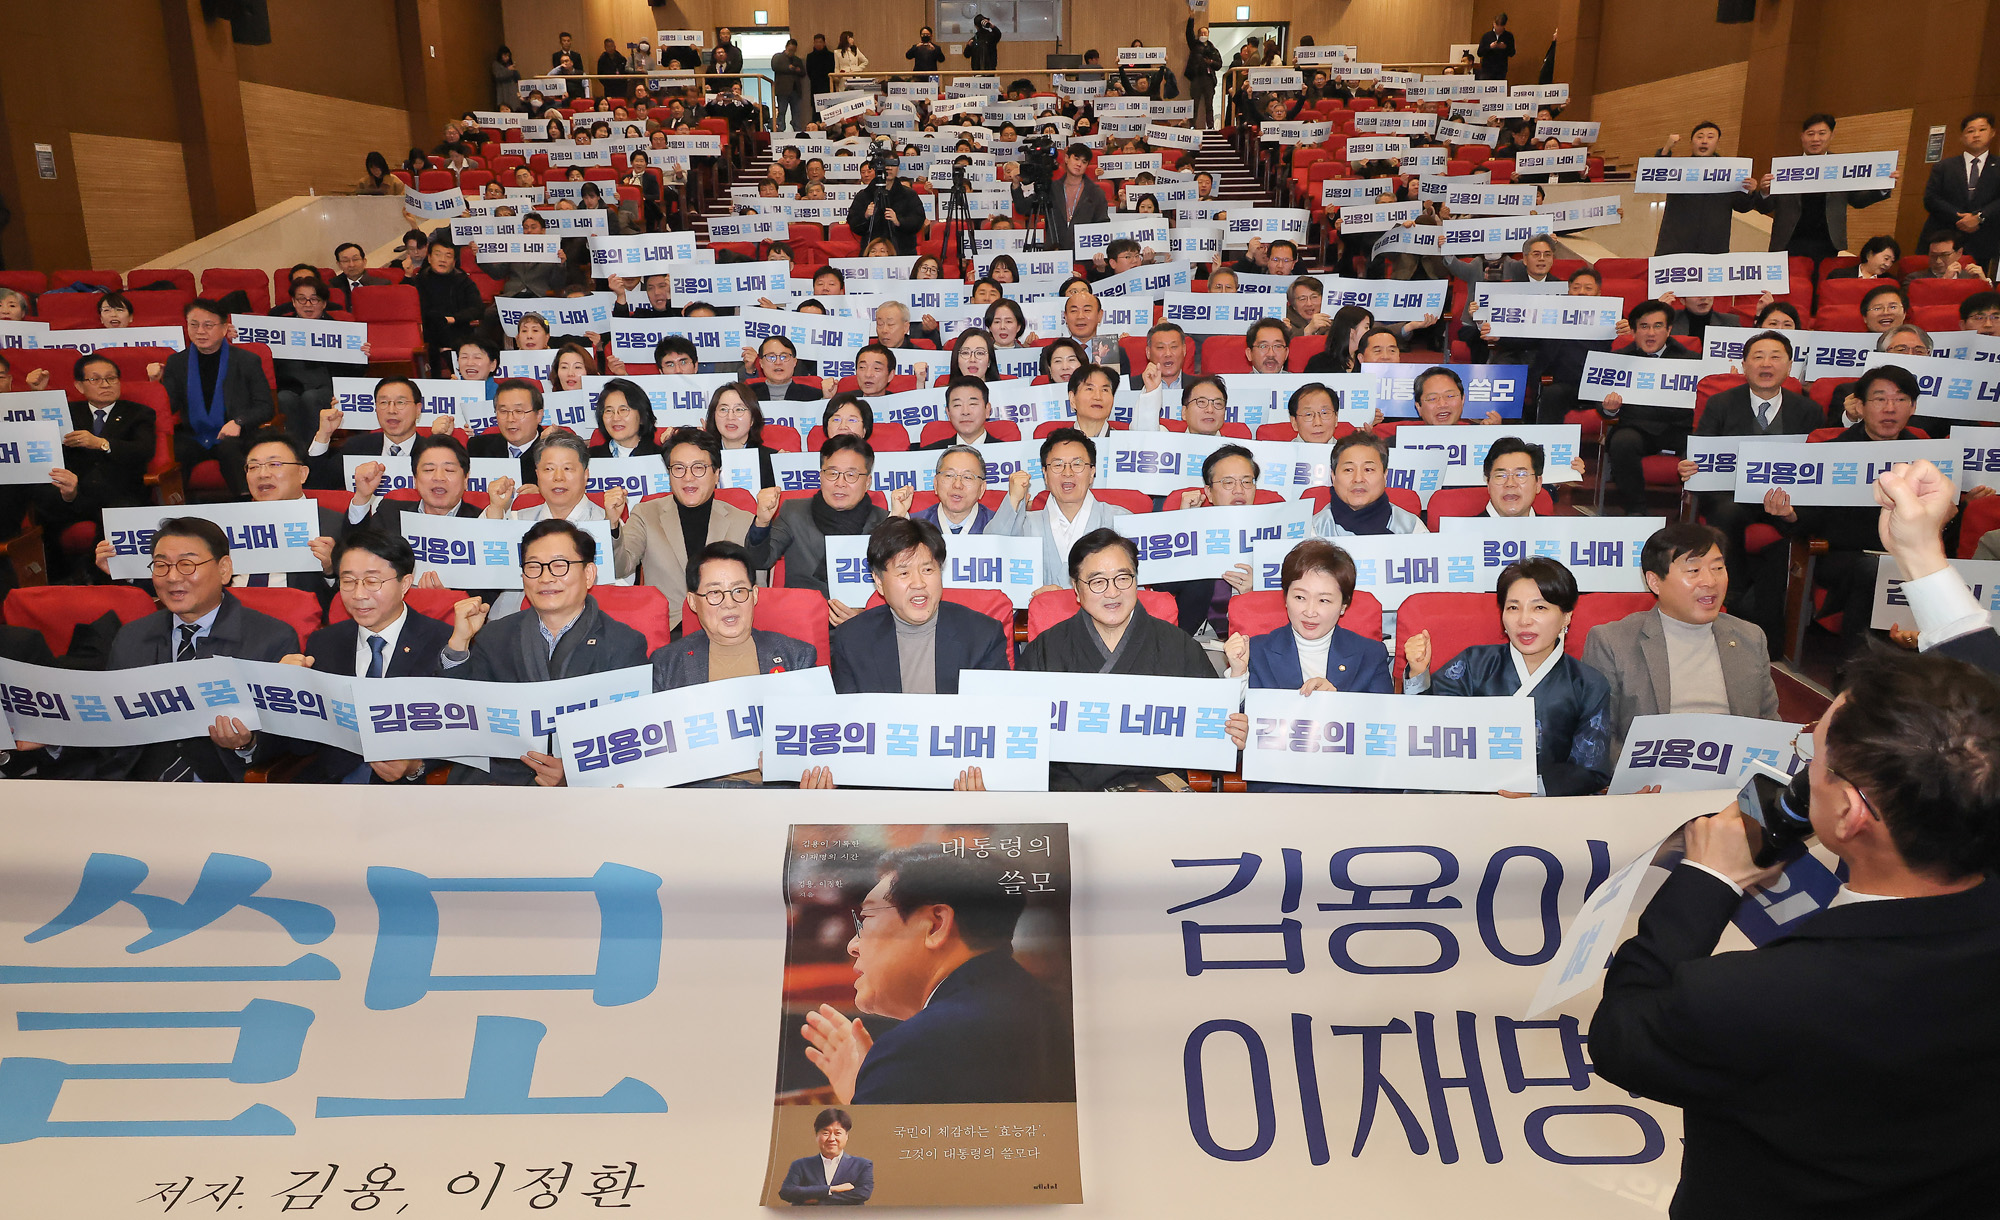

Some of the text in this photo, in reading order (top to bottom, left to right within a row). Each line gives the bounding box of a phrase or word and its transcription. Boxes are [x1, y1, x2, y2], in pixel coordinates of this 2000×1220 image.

[1177, 135, 1191, 143] 너머
[1135, 161, 1150, 169] 너머
[1557, 156, 1573, 164] 너머
[1642, 169, 1731, 182] 김용의 꿈 너머
[1777, 163, 1891, 181] 김용의 꿈 너머 꿈
[1450, 193, 1519, 205] 김용의 너머
[712, 225, 740, 235] 김용의
[1230, 219, 1302, 232] 김용의 꿈 너머
[1446, 227, 1532, 243] 김용의 꿈 너머
[476, 243, 543, 253] 김용의 너머
[592, 244, 691, 264] 김용의 꿈 너머 꿈
[1031, 261, 1069, 274] 너머 꿈
[1655, 265, 1782, 284] 김용의 꿈 너머 꿈
[674, 274, 785, 293] 김용의 꿈 너머 꿈
[1129, 271, 1186, 293] 꿈 너머 꿈
[911, 293, 959, 307] 너머 꿈
[1328, 291, 1440, 308] 김용의 꿈 너머 꿈
[559, 306, 607, 324] 너머 꿈
[1103, 310, 1148, 324] 너머 꿈
[1168, 305, 1263, 321] 김용의 꿈 너머
[1562, 310, 1616, 325] 너머 꿈
[238, 328, 361, 350] 김용의 꿈 너머 꿈
[616, 331, 740, 348] 김용의 꿈
[745, 321, 863, 347] 김용의 꿈 너머 꿈
[1587, 367, 1697, 391] 김용의 꿈 너머
[1947, 378, 1973, 400] 꿈
[650, 391, 709, 409] 꿈 너머
[1351, 390, 1369, 409] 꿈
[1469, 380, 1515, 402] 쓸모
[887, 405, 938, 425] 김용의
[1244, 406, 1262, 424] 꿈
[27, 441, 52, 463] 꿈
[1116, 451, 1181, 475] 김용의
[1551, 444, 1572, 466] 꿈
[872, 471, 917, 494] 너머
[1264, 463, 1287, 486] 꿈
[1419, 470, 1439, 491] 꿈
[1746, 462, 1858, 484] 김용의 꿈
[229, 522, 310, 549] 너머 꿈
[1130, 529, 1230, 561] 김용의 꿈
[408, 535, 509, 566] 김용의 꿈
[1570, 541, 1623, 567] 너머
[952, 557, 1033, 585] 너머 꿈
[1386, 556, 1475, 584] 너머 꿈
[72, 680, 240, 722] 꿈 너머 꿈
[369, 703, 520, 737] 김용의 꿈
[1078, 702, 1110, 733] 꿈
[1120, 704, 1186, 737] 너머
[1195, 707, 1228, 739] 꿈
[573, 712, 719, 772] 김용의 꿈
[775, 723, 1038, 759] 김용의 꿈 너머 꿈
[1256, 718, 1523, 760] 김용의 꿈 너머 꿈
[1629, 739, 1733, 775] 김용의
[941, 836, 1051, 858] 대통령의
[998, 870, 1055, 895] 쓸모
[0, 852, 668, 1145] 쓸모
[893, 1125, 931, 1138] 국민이
[937, 1125, 990, 1138] 체감하는
[899, 1147, 1041, 1160] 그것이 대통령의 쓸모다
[136, 1160, 646, 1216] 저자. 김용, 이정환
